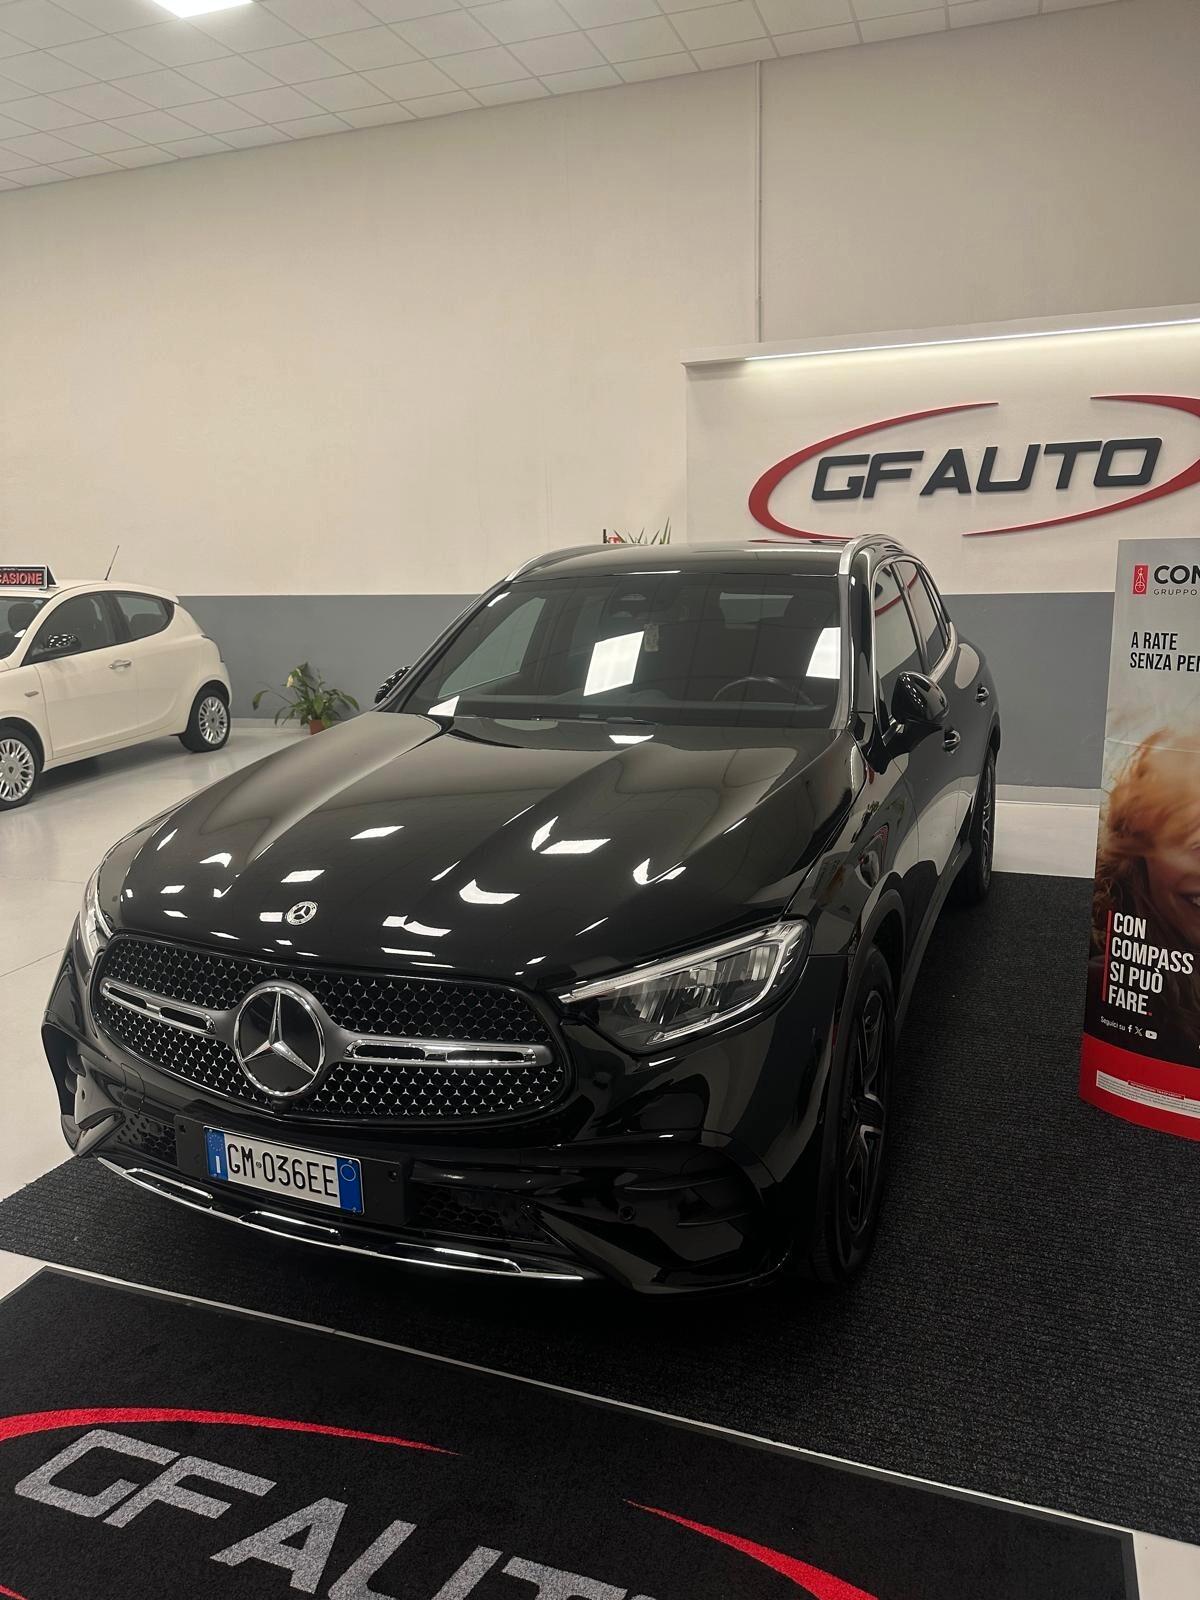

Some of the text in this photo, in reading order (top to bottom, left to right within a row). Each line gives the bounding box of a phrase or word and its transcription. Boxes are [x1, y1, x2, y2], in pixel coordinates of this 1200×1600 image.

[811, 437, 1163, 501] GF AUTO
[0, 572, 43, 585] ASIONE
[1153, 588, 1198, 596] GRUPPO
[1131, 631, 1178, 650] A RATE
[1130, 651, 1172, 670] SENZA
[1113, 912, 1147, 940] CON
[1111, 936, 1194, 975] COMPASS
[1109, 961, 1163, 994] SI PUÒ
[14, 1428, 657, 1600] GF AUT
